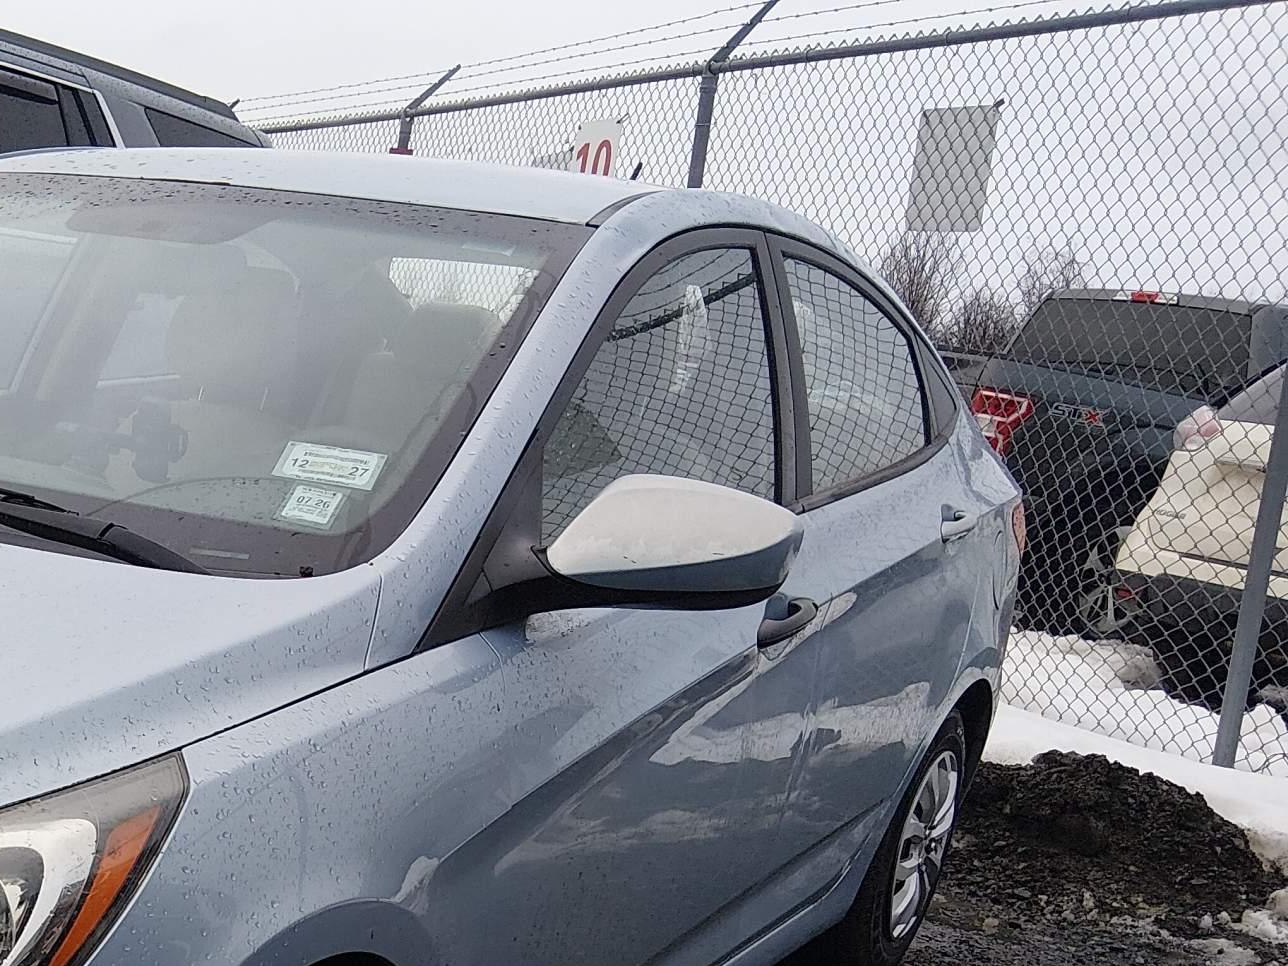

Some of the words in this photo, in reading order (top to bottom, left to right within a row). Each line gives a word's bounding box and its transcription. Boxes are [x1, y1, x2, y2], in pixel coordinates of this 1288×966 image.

[576, 139, 612, 176] 10
[1050, 402, 1103, 426] STX
[290, 457, 310, 469] 12
[348, 466, 370, 478] 27
[296, 495, 312, 505] 07
